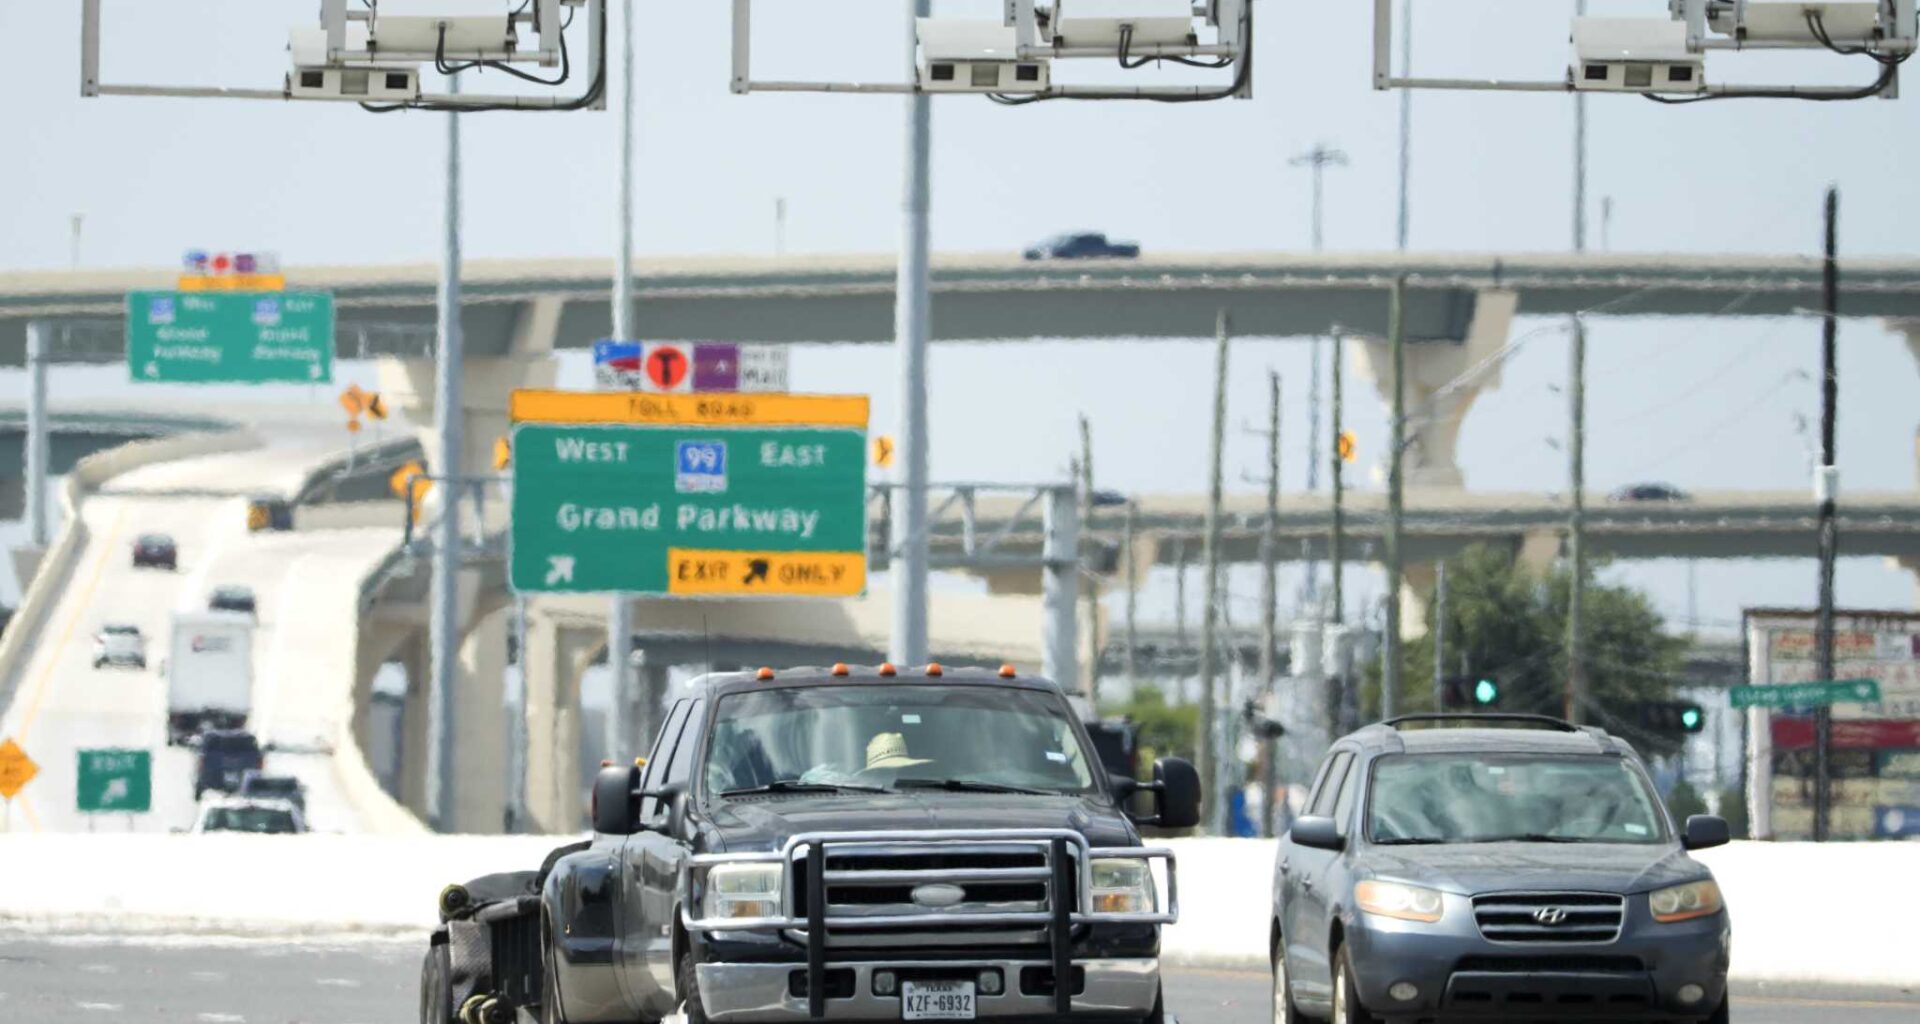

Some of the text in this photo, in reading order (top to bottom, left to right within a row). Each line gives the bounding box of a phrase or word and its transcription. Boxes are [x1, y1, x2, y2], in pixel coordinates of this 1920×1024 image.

[628, 398, 755, 418] TOLL ROAD
[555, 437, 629, 463] WEST
[686, 446, 717, 471] 99
[760, 441, 826, 467] EAST
[556, 502, 820, 538] Grand Parkway
[677, 559, 846, 586] EXIT ONLY
